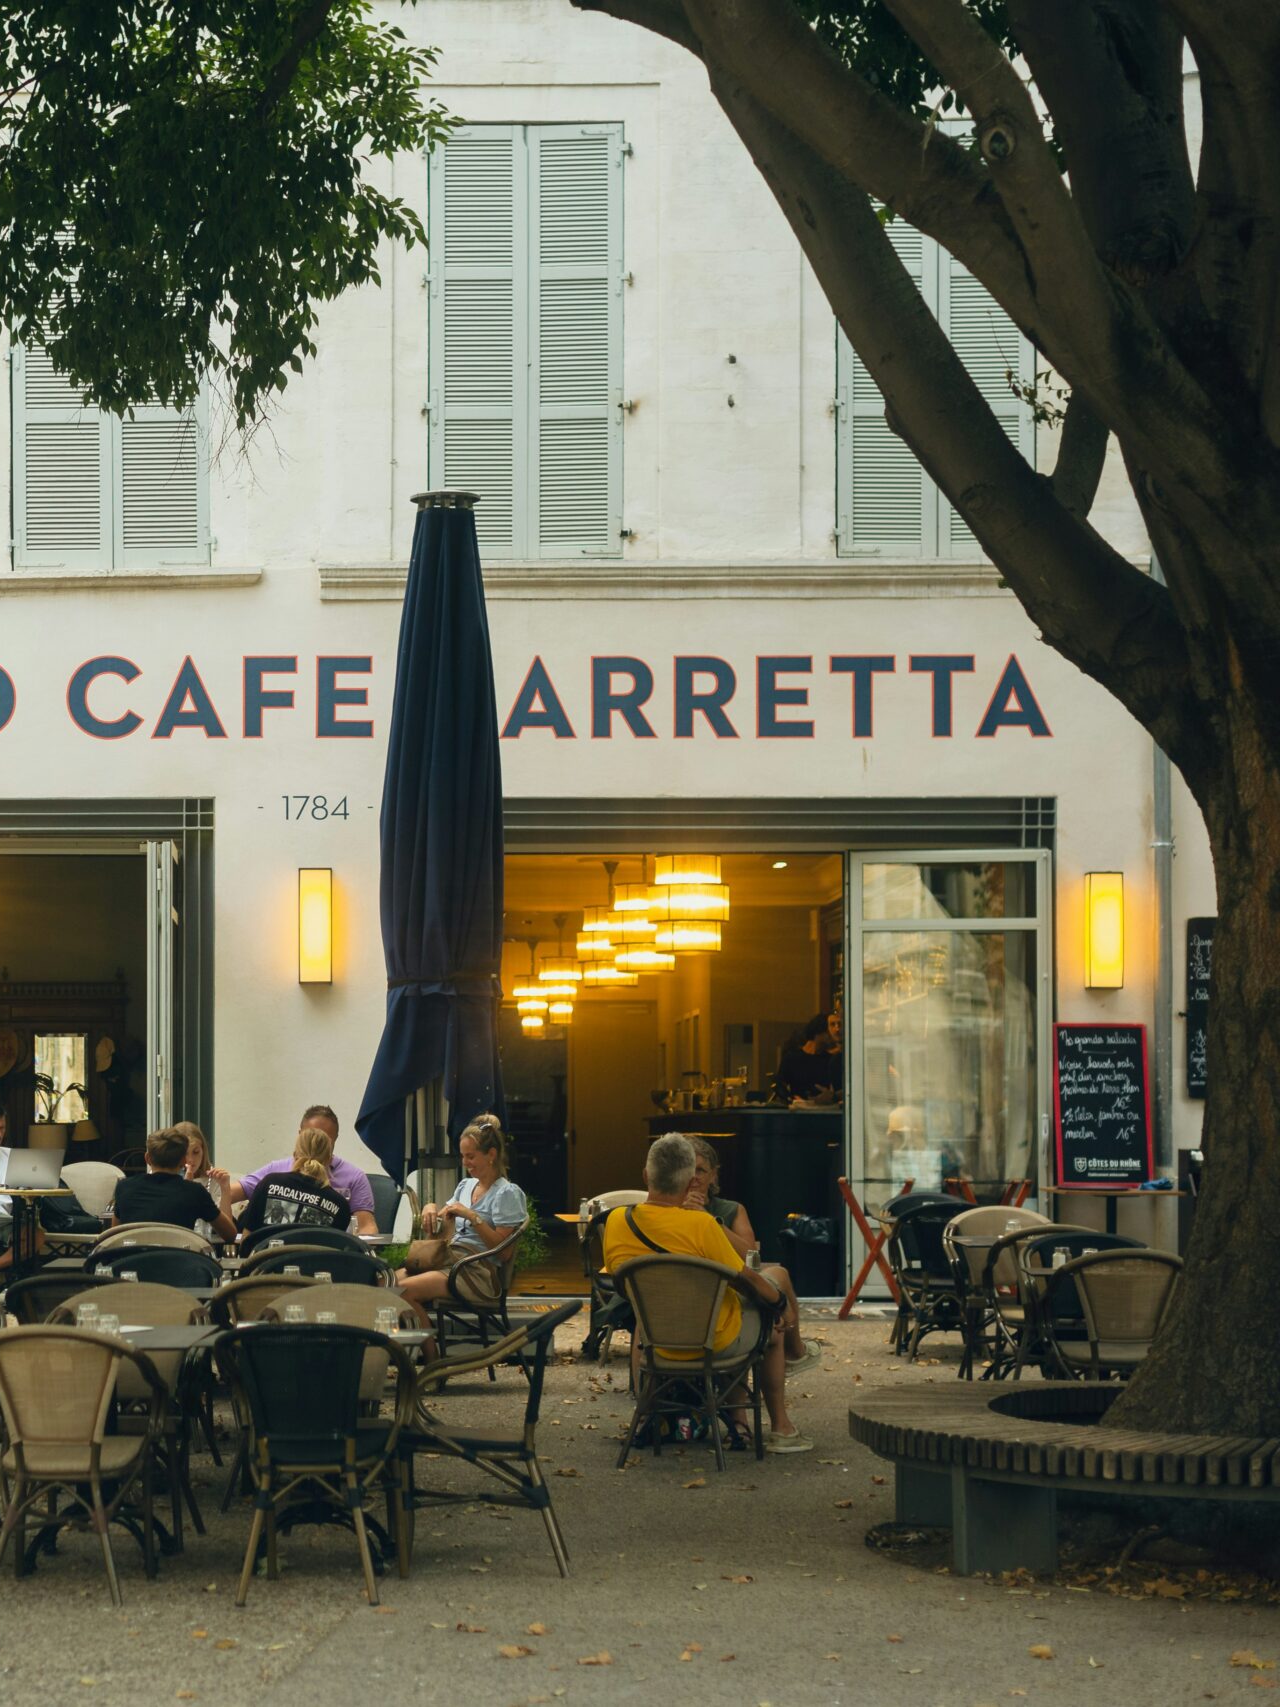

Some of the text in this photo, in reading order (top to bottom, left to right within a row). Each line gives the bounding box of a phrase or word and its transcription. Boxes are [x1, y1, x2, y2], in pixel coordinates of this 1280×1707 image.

[66, 655, 375, 740] CAFE
[499, 653, 1054, 739] ARRETTA
[282, 795, 350, 820] 1784
[1088, 1157, 1141, 1168] CÔTES DU RHÔNE
[267, 1184, 340, 1215] 2PACALYPSE NOW
